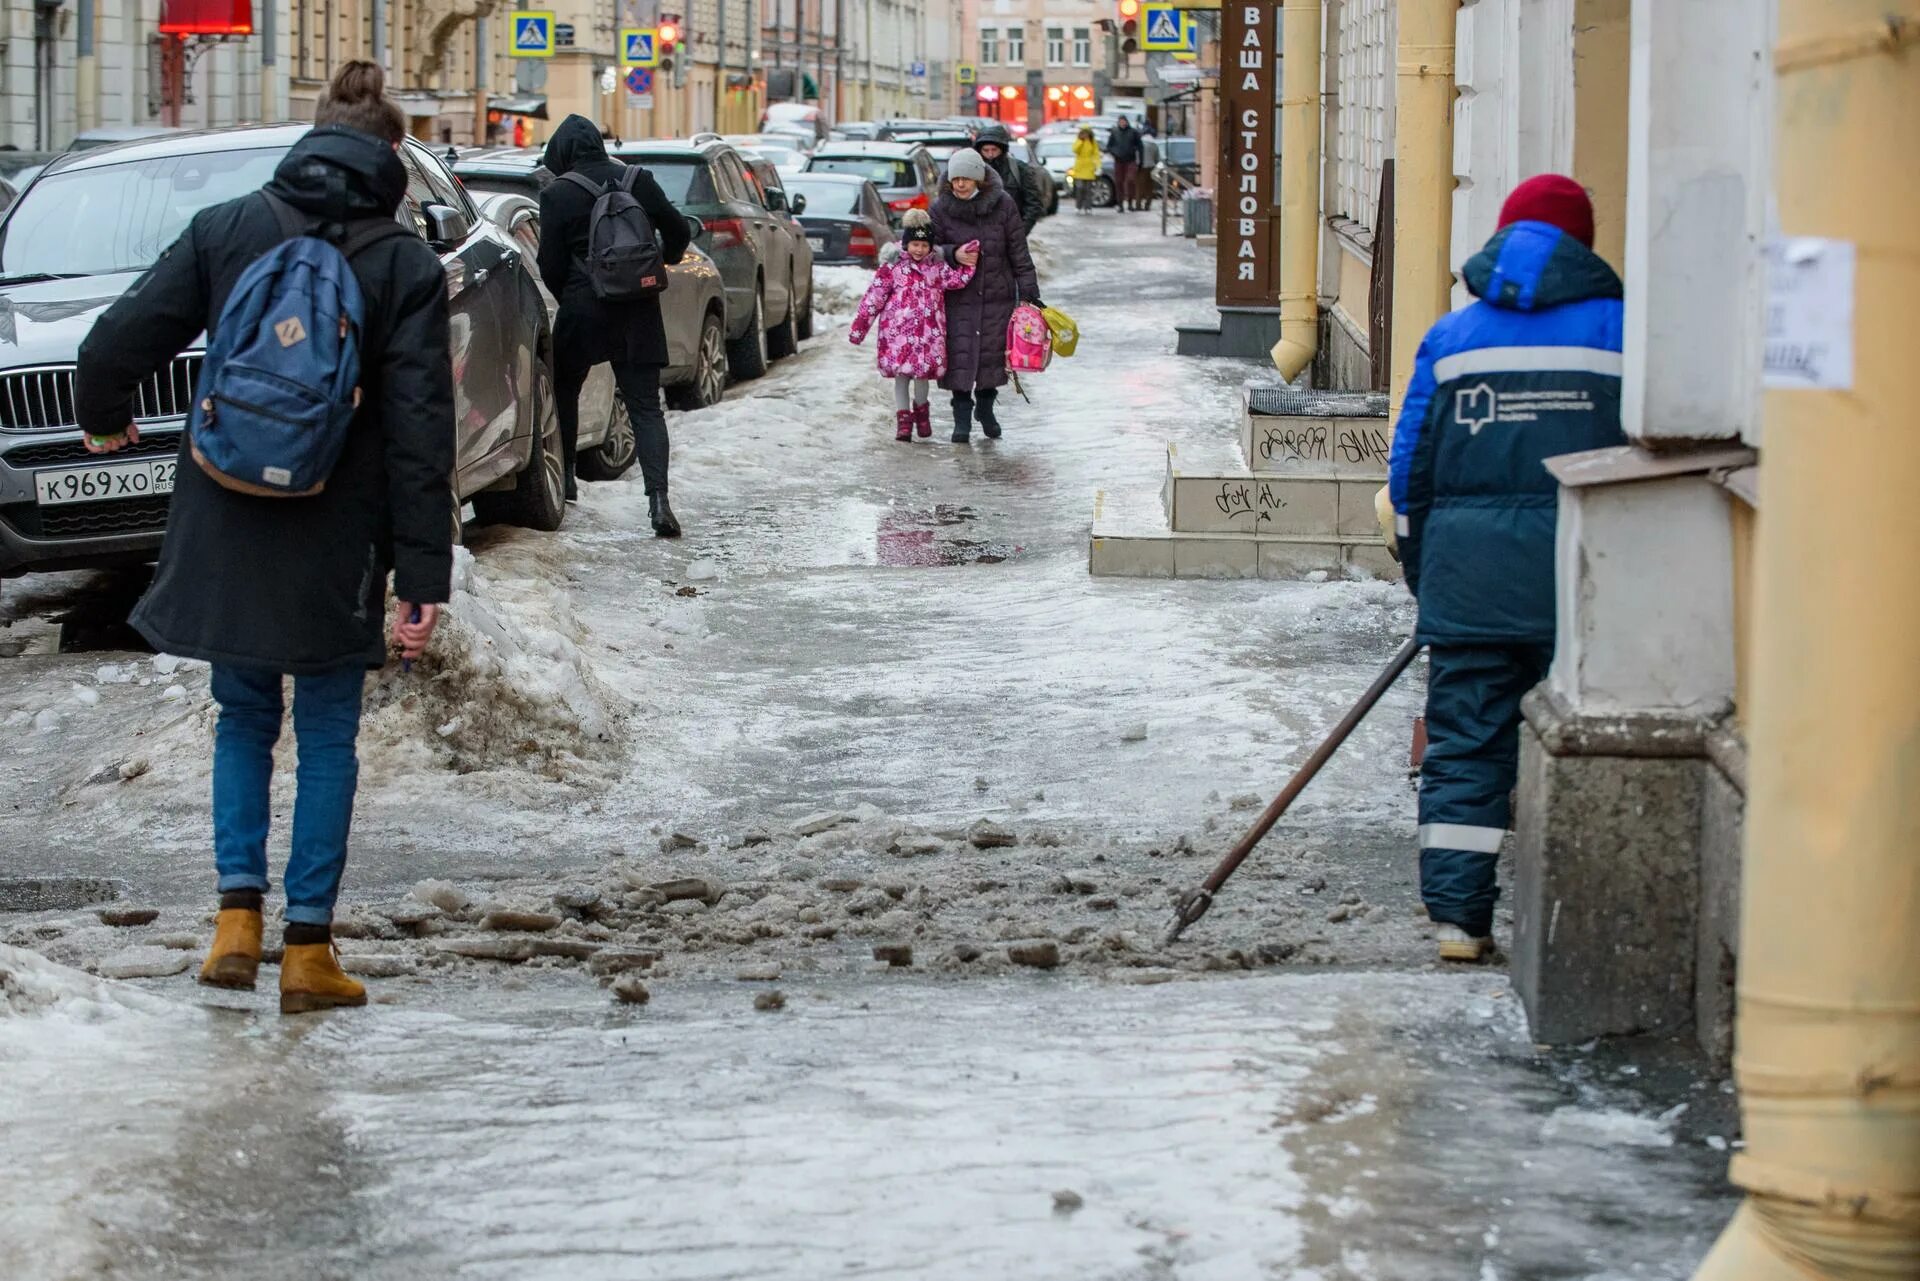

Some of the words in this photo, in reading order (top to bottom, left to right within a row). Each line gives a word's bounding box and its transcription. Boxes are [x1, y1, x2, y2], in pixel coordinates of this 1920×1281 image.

[1239, 7, 1262, 90] ВАША
[1237, 109, 1259, 281] СТОЛОВАЯ
[154, 480, 174, 491] RUS
